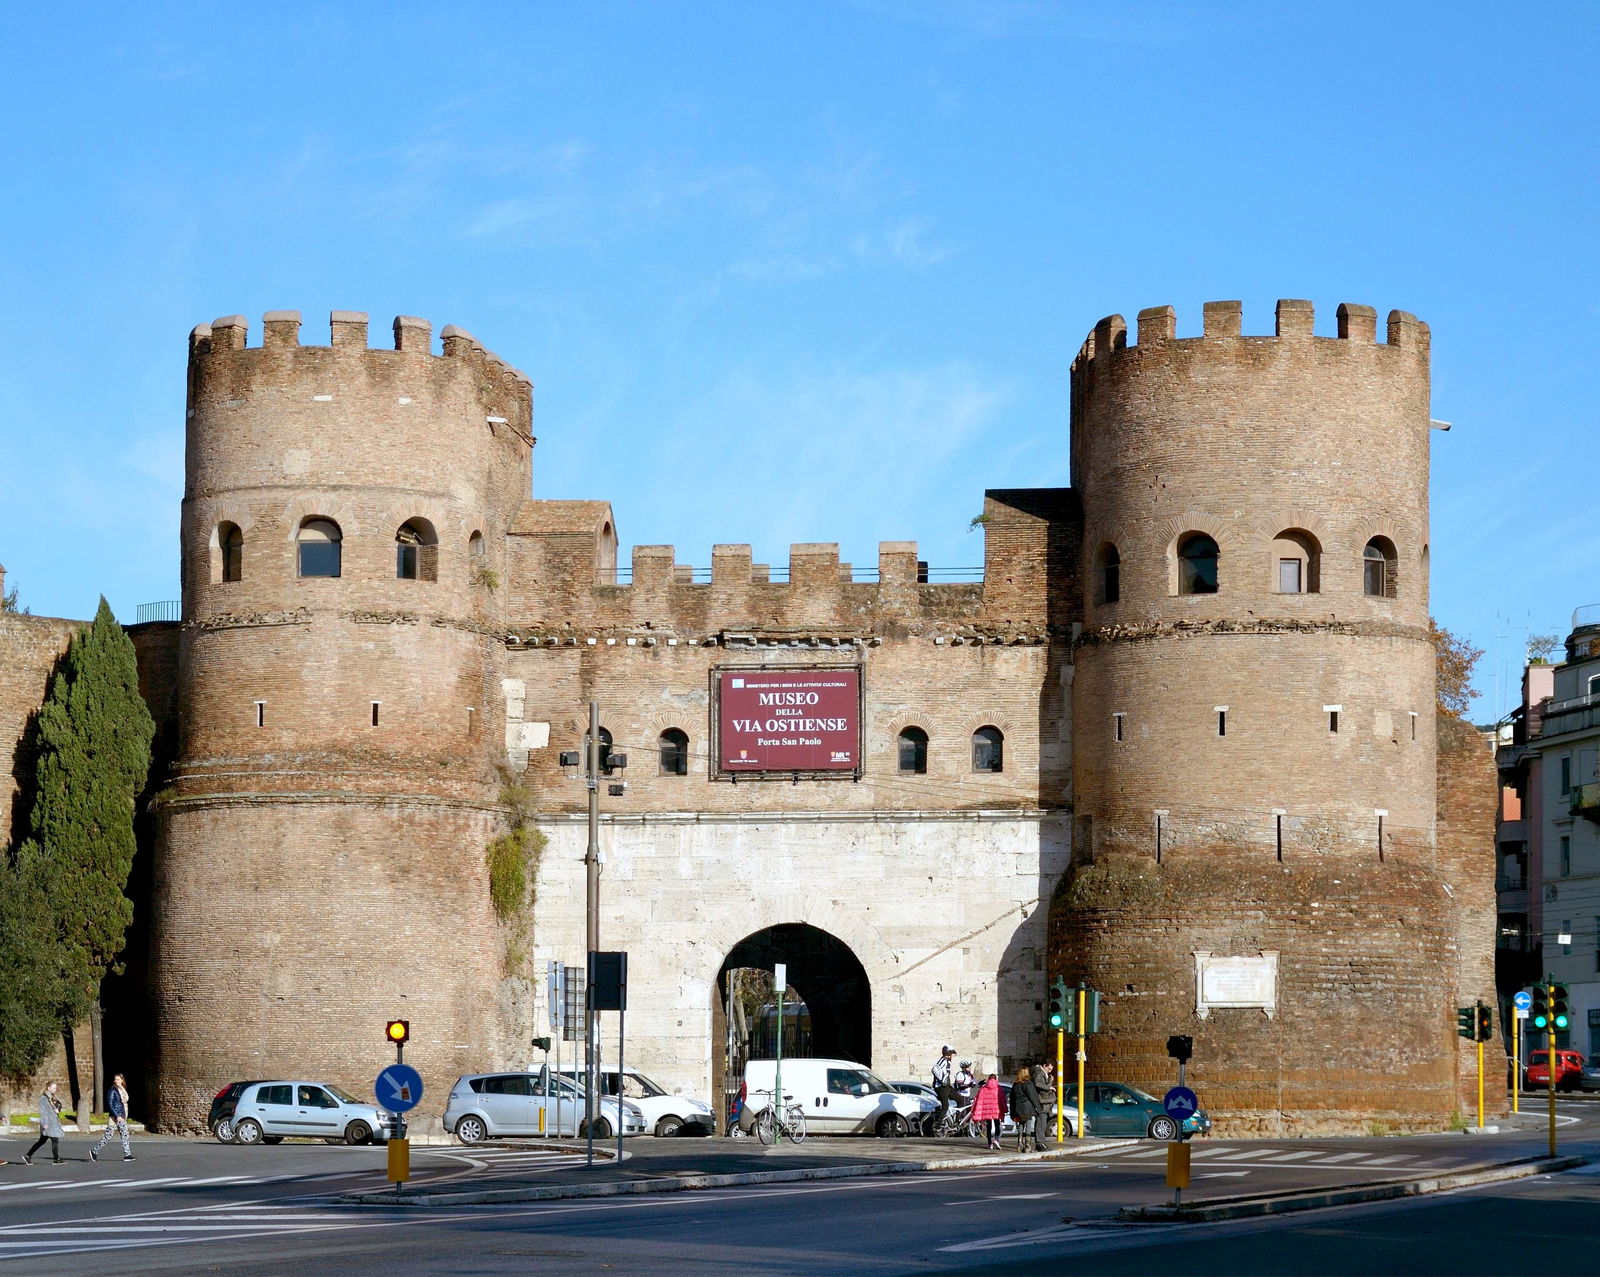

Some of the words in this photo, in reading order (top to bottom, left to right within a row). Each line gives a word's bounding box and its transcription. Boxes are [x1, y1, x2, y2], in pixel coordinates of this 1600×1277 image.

[758, 692, 819, 706] MUSEO
[775, 708, 803, 716] DELLA
[732, 719, 763, 733] VIA
[765, 718, 848, 732] OSTIENSE
[757, 738, 780, 746] Porta
[781, 738, 797, 746] San
[799, 737, 822, 745] Paolo
